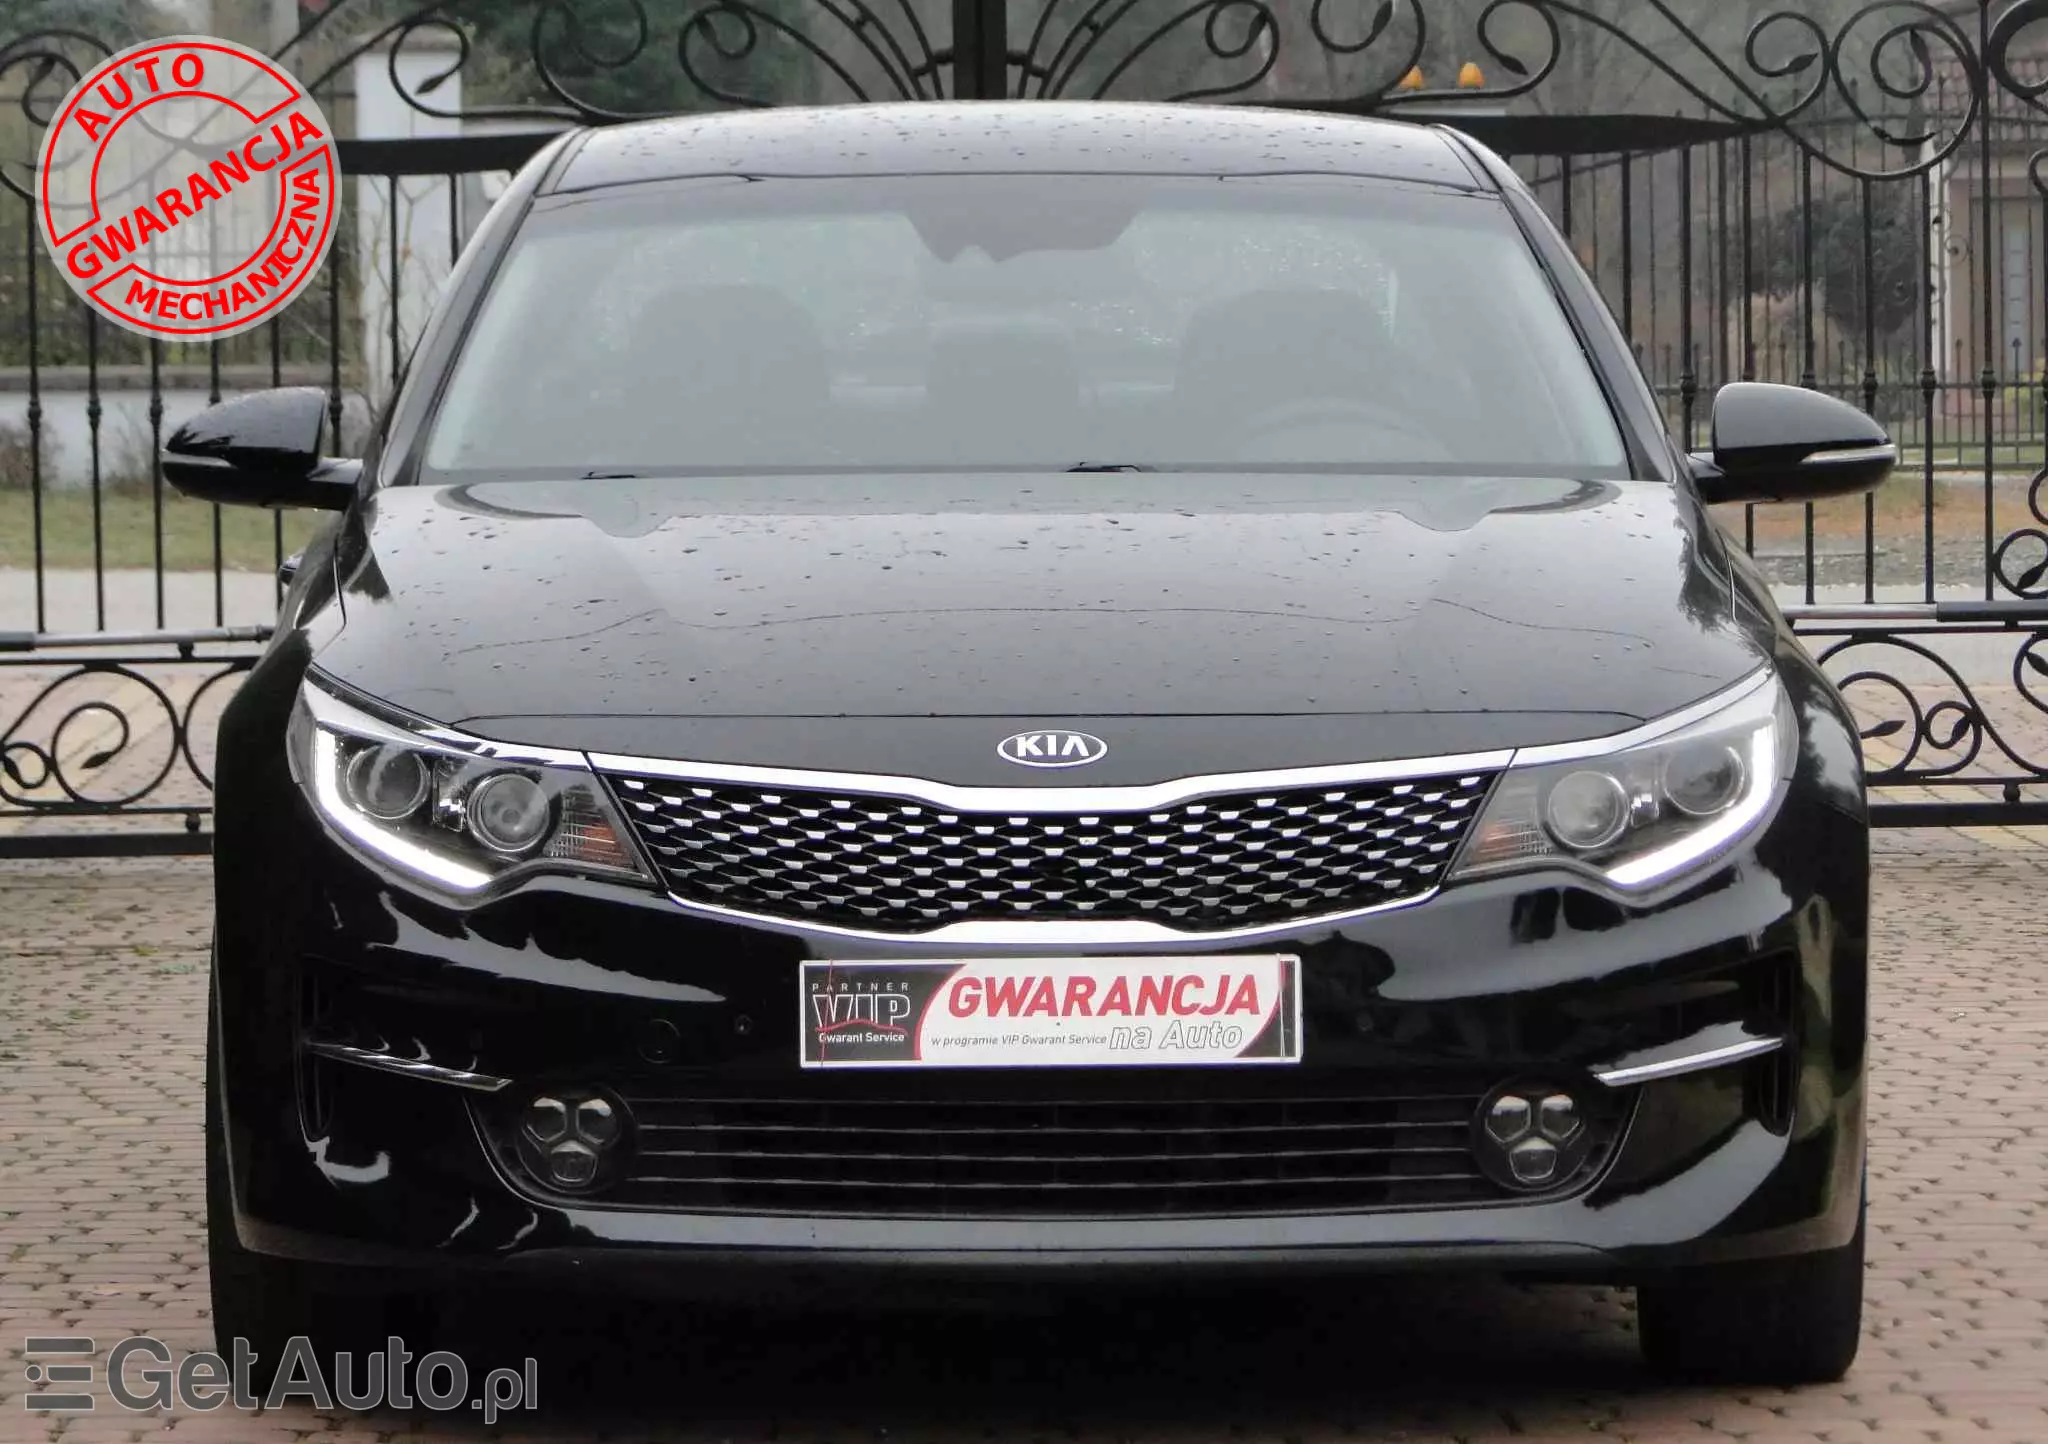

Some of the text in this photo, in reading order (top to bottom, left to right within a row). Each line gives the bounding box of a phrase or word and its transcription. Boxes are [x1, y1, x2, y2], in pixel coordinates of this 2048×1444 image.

[1016, 734, 1090, 757] KIA
[812, 982, 909, 992] PARTNER
[948, 974, 1261, 1017] GWARANCJA
[812, 993, 911, 1028] VIP
[818, 1032, 905, 1043] Gwarant Service
[931, 1034, 1108, 1048] w programie VIP Gwarant Service
[1109, 1020, 1243, 1050] na Auto
